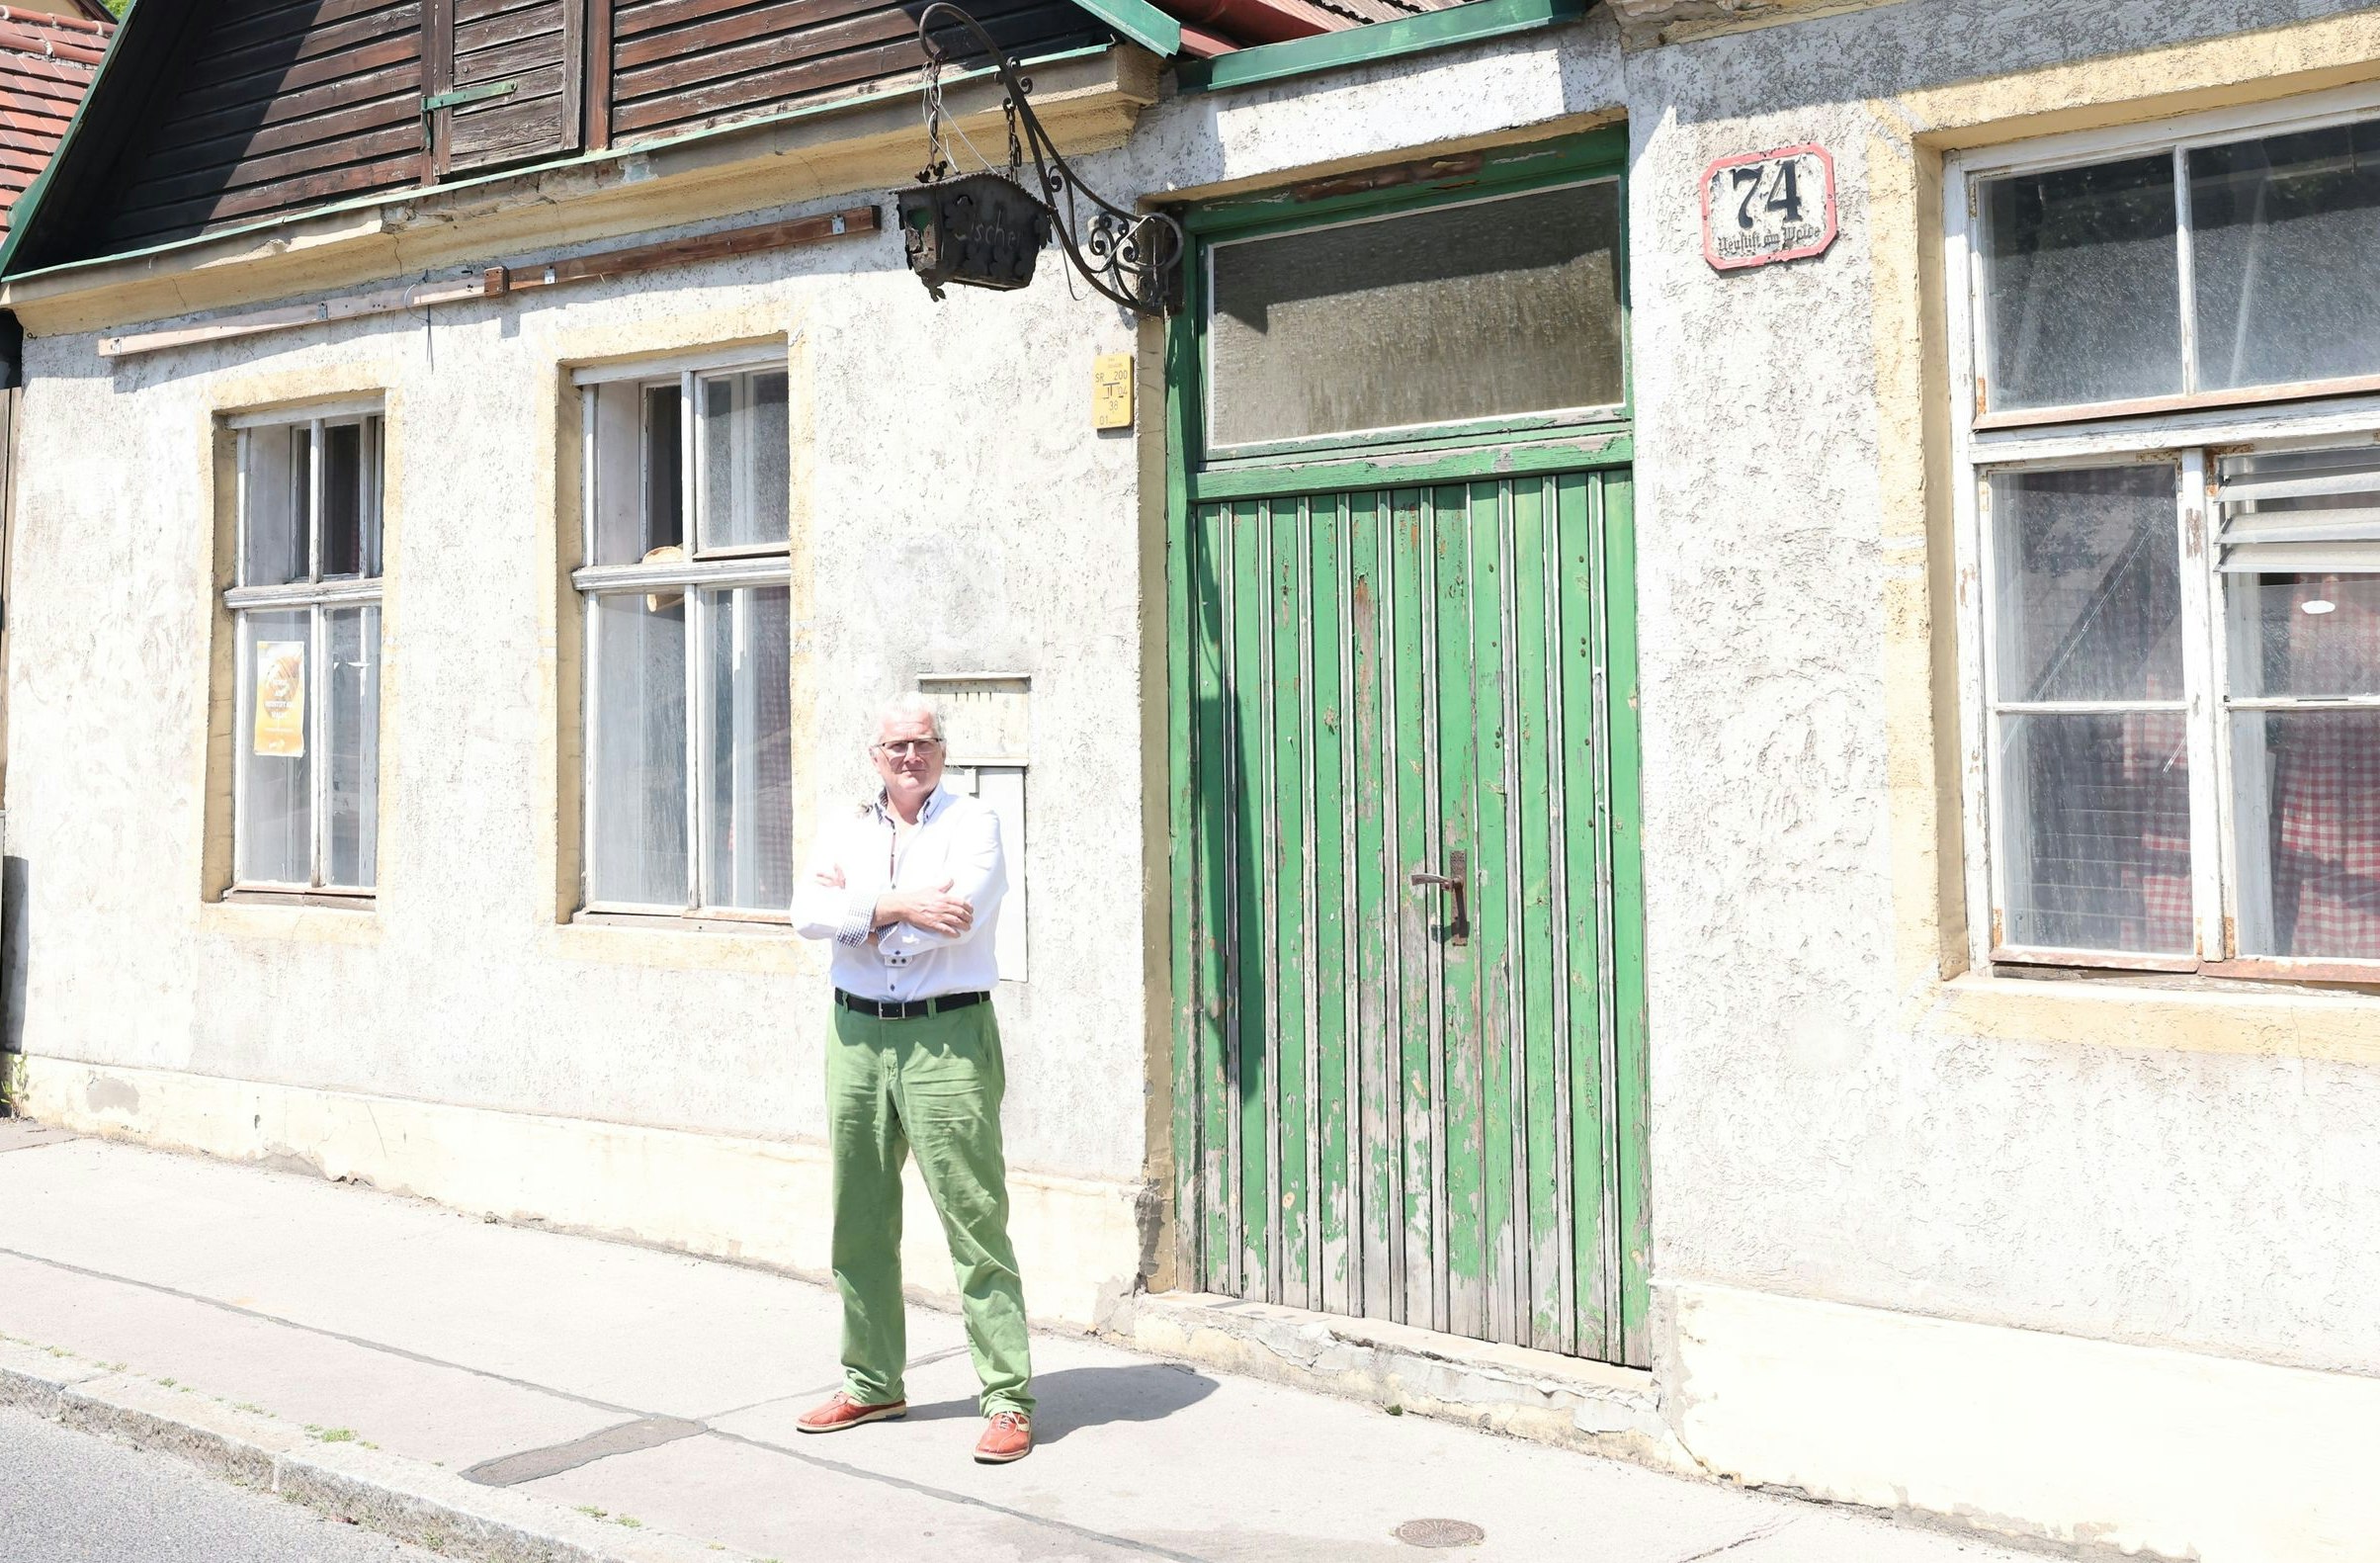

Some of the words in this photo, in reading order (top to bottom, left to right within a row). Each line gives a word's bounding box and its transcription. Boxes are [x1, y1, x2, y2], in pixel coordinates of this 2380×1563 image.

[1730, 159, 1803, 229] 74
[1095, 372, 1104, 383] SR
[1114, 370, 1128, 381] 200
